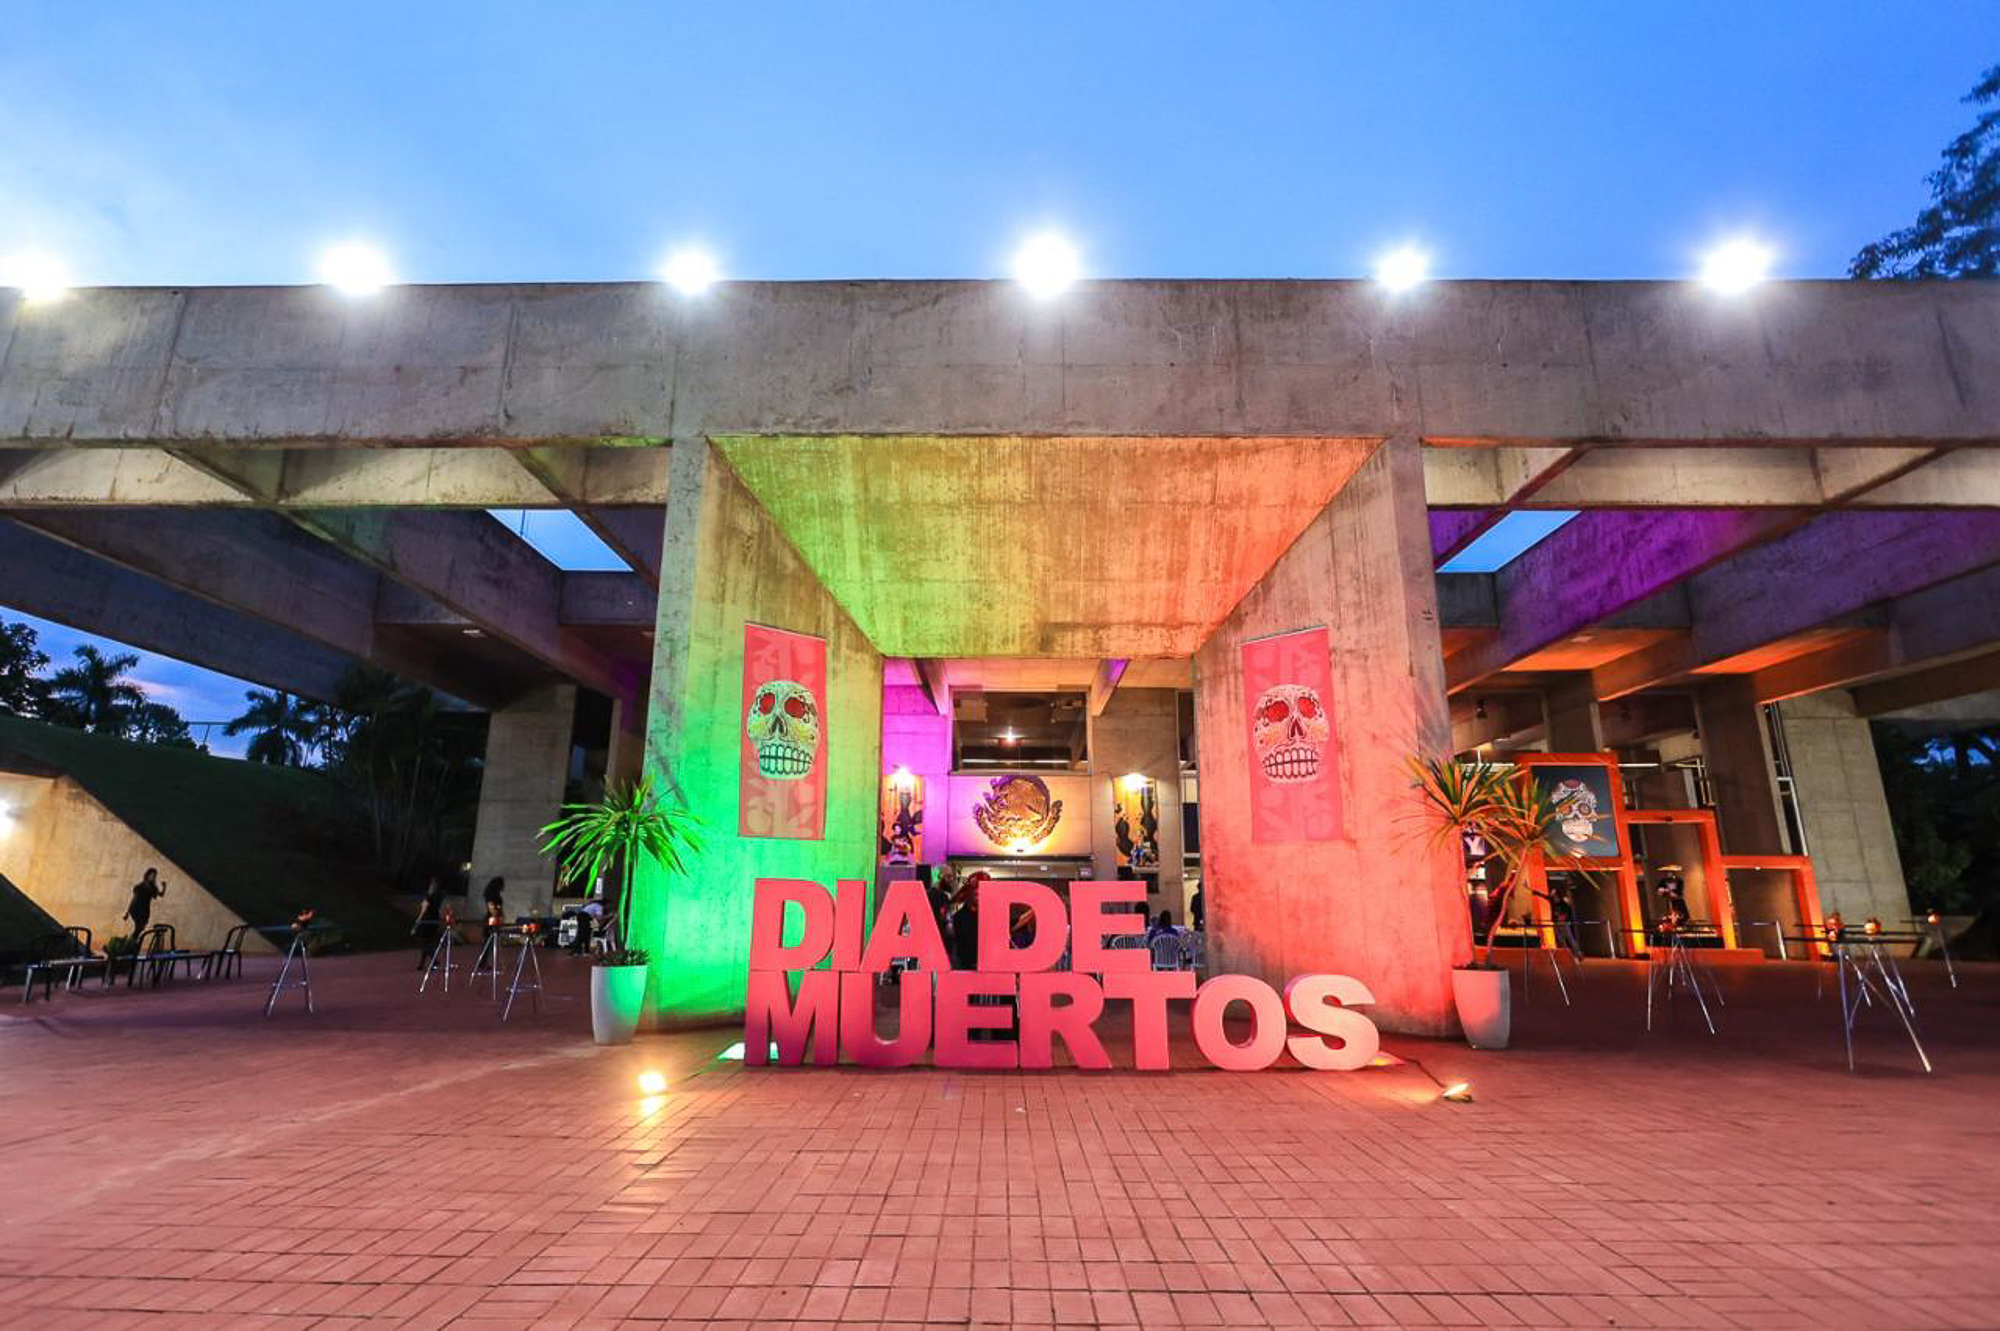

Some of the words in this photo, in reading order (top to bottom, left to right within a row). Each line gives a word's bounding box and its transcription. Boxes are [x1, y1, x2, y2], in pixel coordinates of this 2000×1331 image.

[750, 878, 951, 972] DIA
[977, 880, 1151, 972] DE
[744, 970, 1381, 1071] MUERTOS
